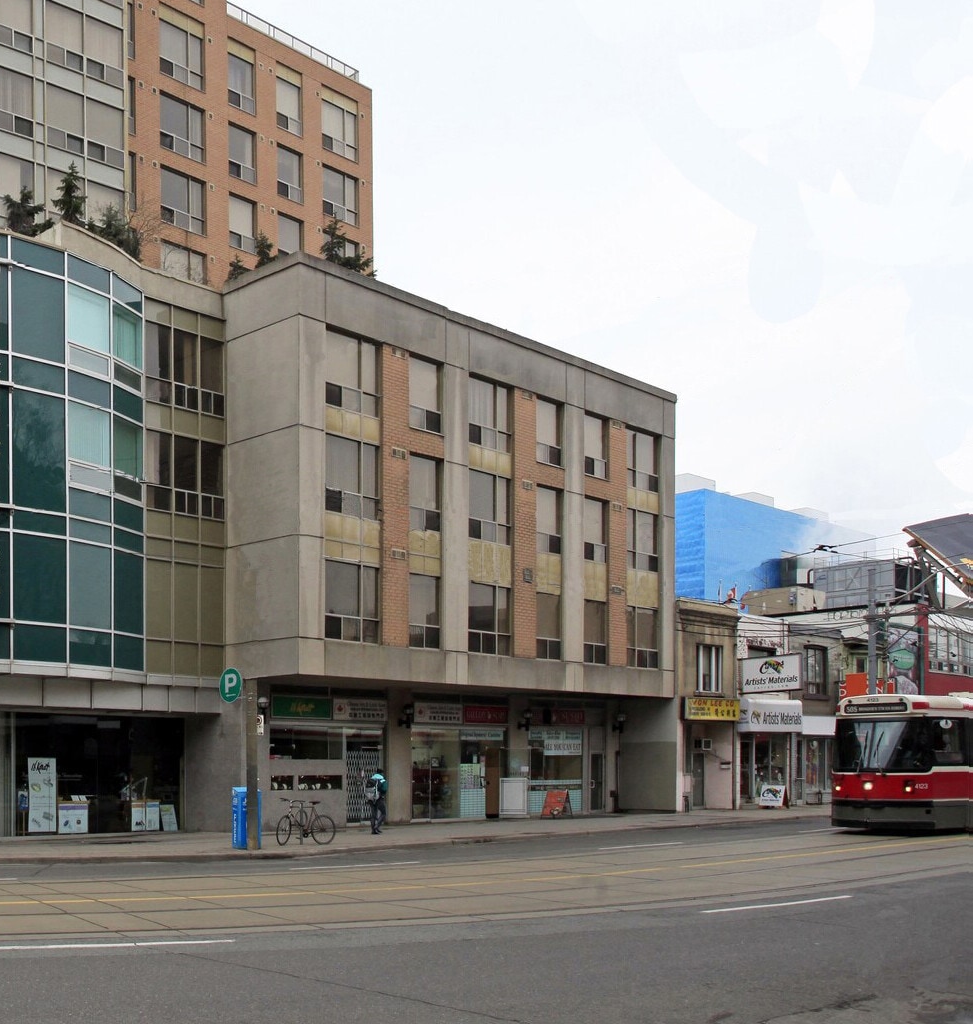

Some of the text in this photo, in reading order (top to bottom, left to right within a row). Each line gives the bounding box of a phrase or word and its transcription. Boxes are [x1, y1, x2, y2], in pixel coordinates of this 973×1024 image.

[745, 674, 798, 686] Artists' Materials
[762, 712, 802, 725] Artists' Materials
